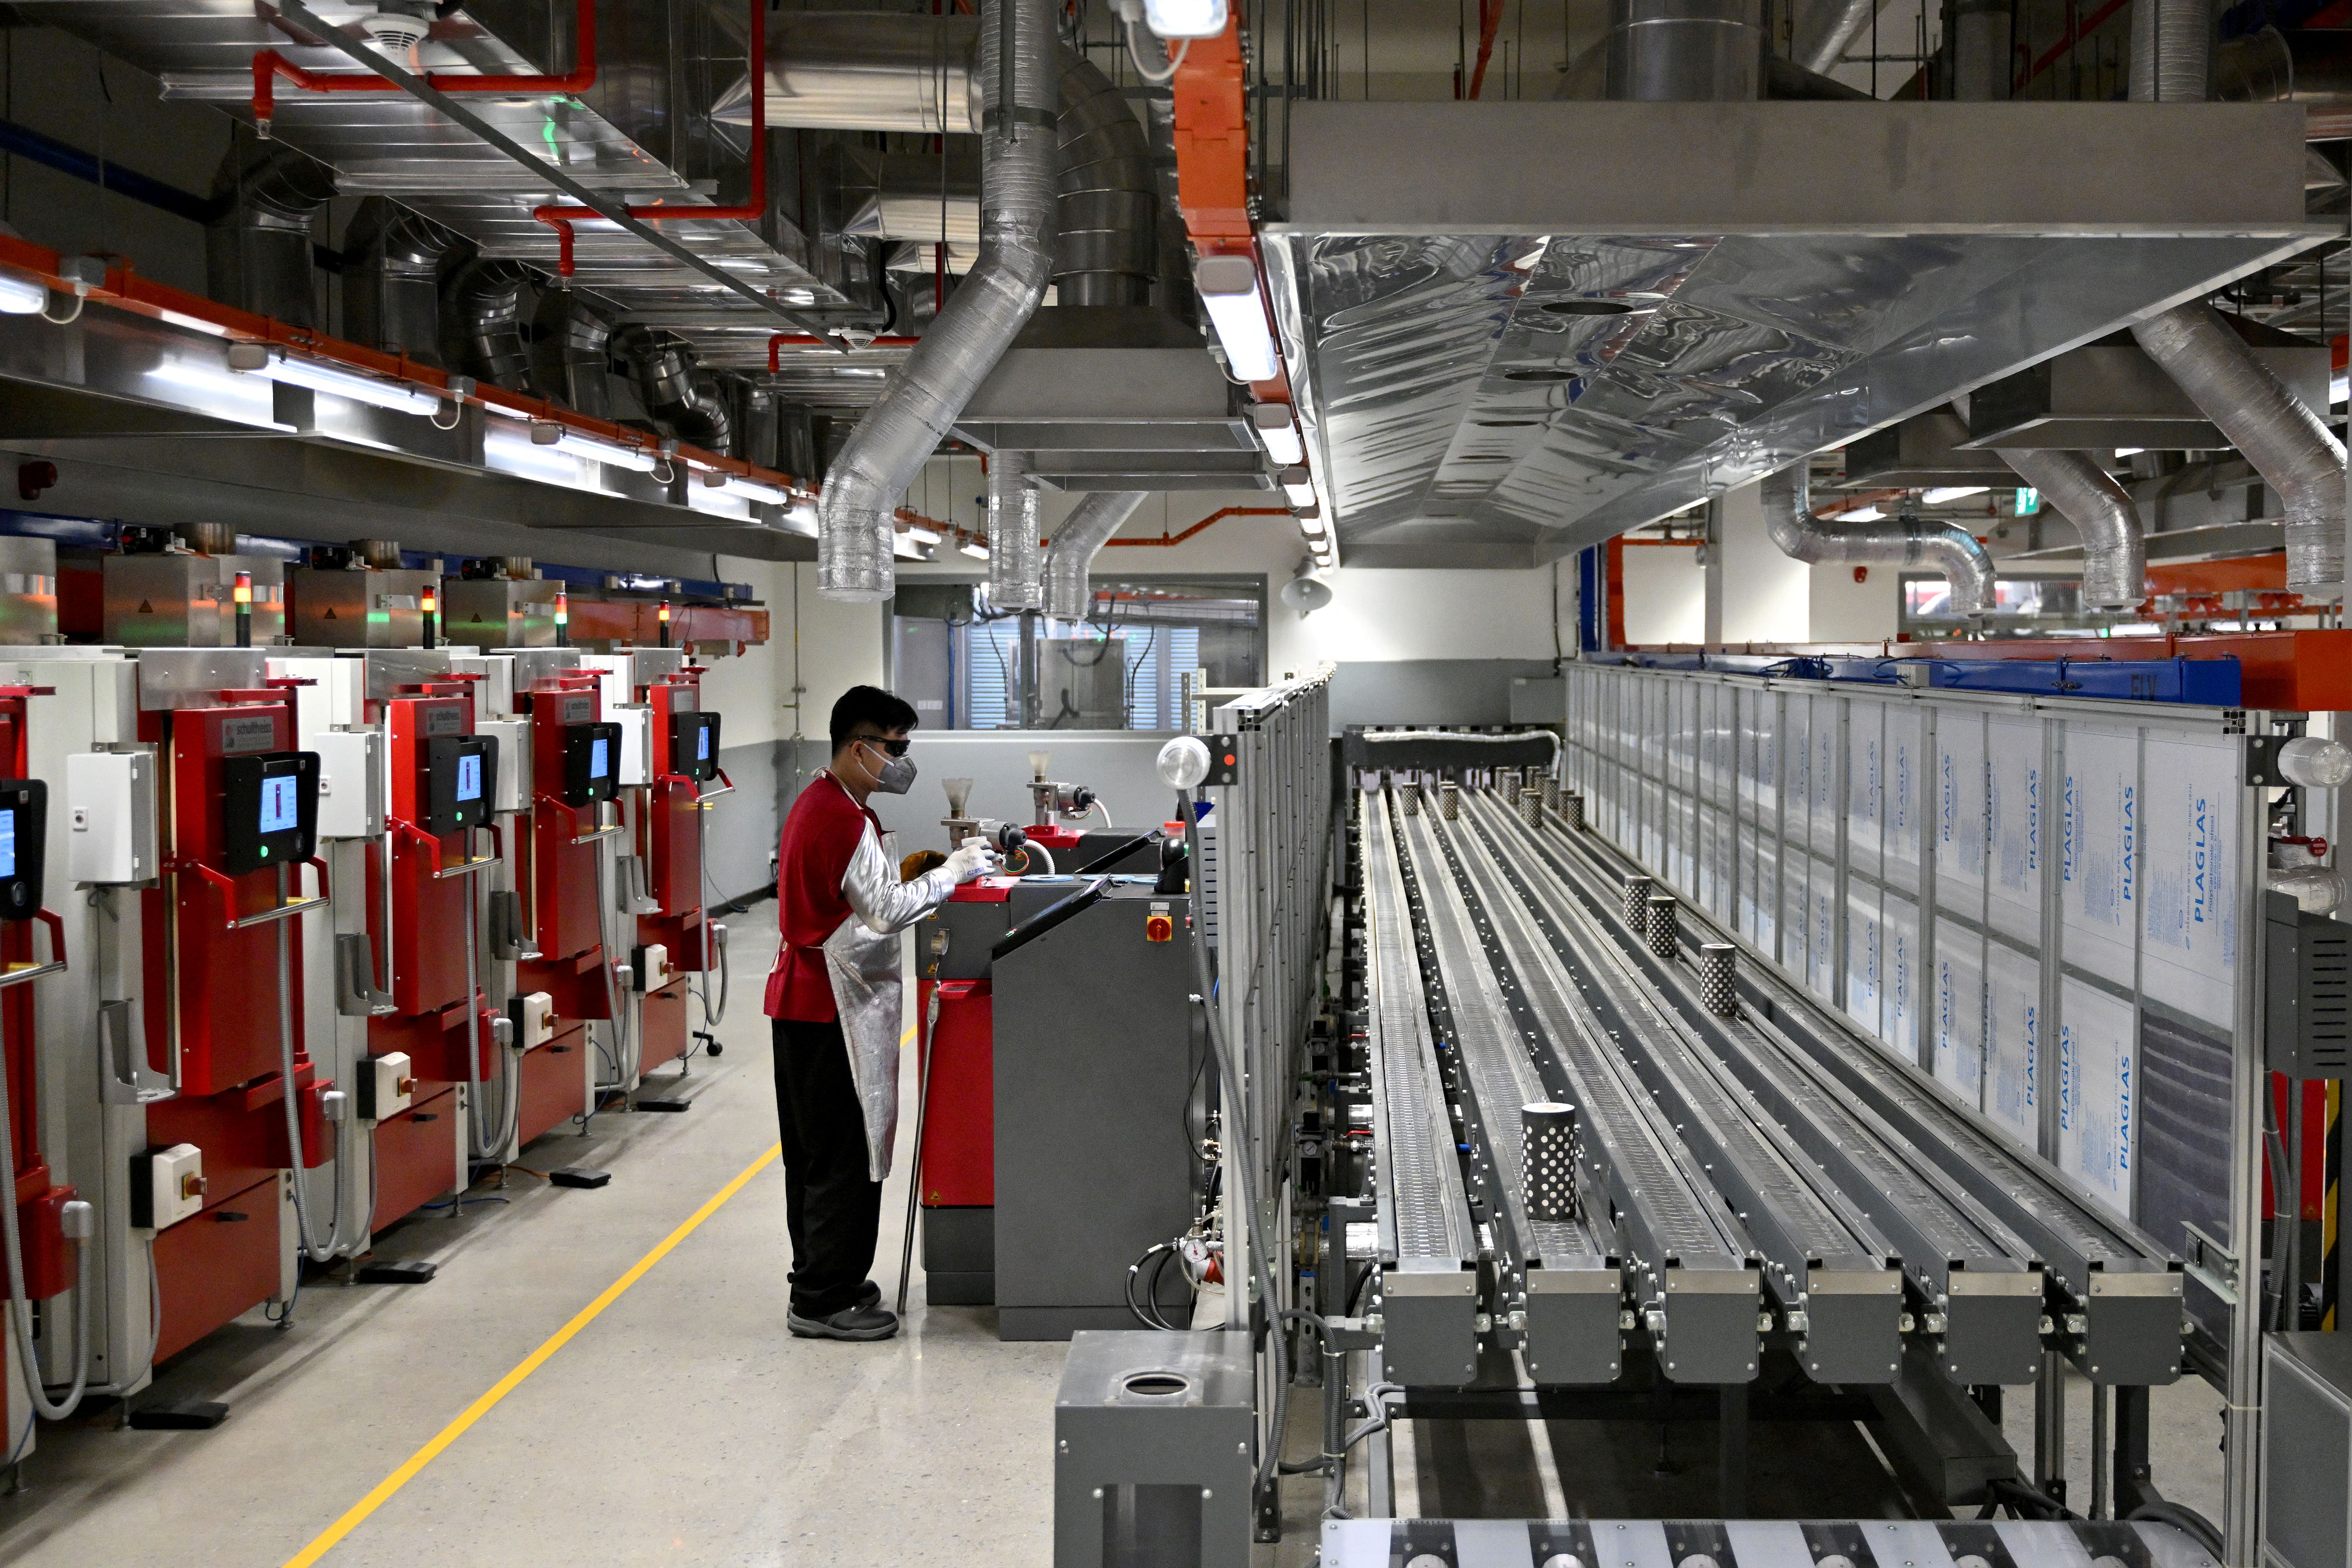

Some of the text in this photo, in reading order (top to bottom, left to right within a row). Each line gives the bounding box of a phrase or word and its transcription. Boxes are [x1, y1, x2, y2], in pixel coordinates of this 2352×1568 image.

[2064, 776, 2072, 881] PLAGLAS
[2123, 786, 2132, 901] PLAGLAS
[2194, 799, 2206, 923] PLAGLAS
[2120, 1056, 2129, 1170] PLAGLAS
